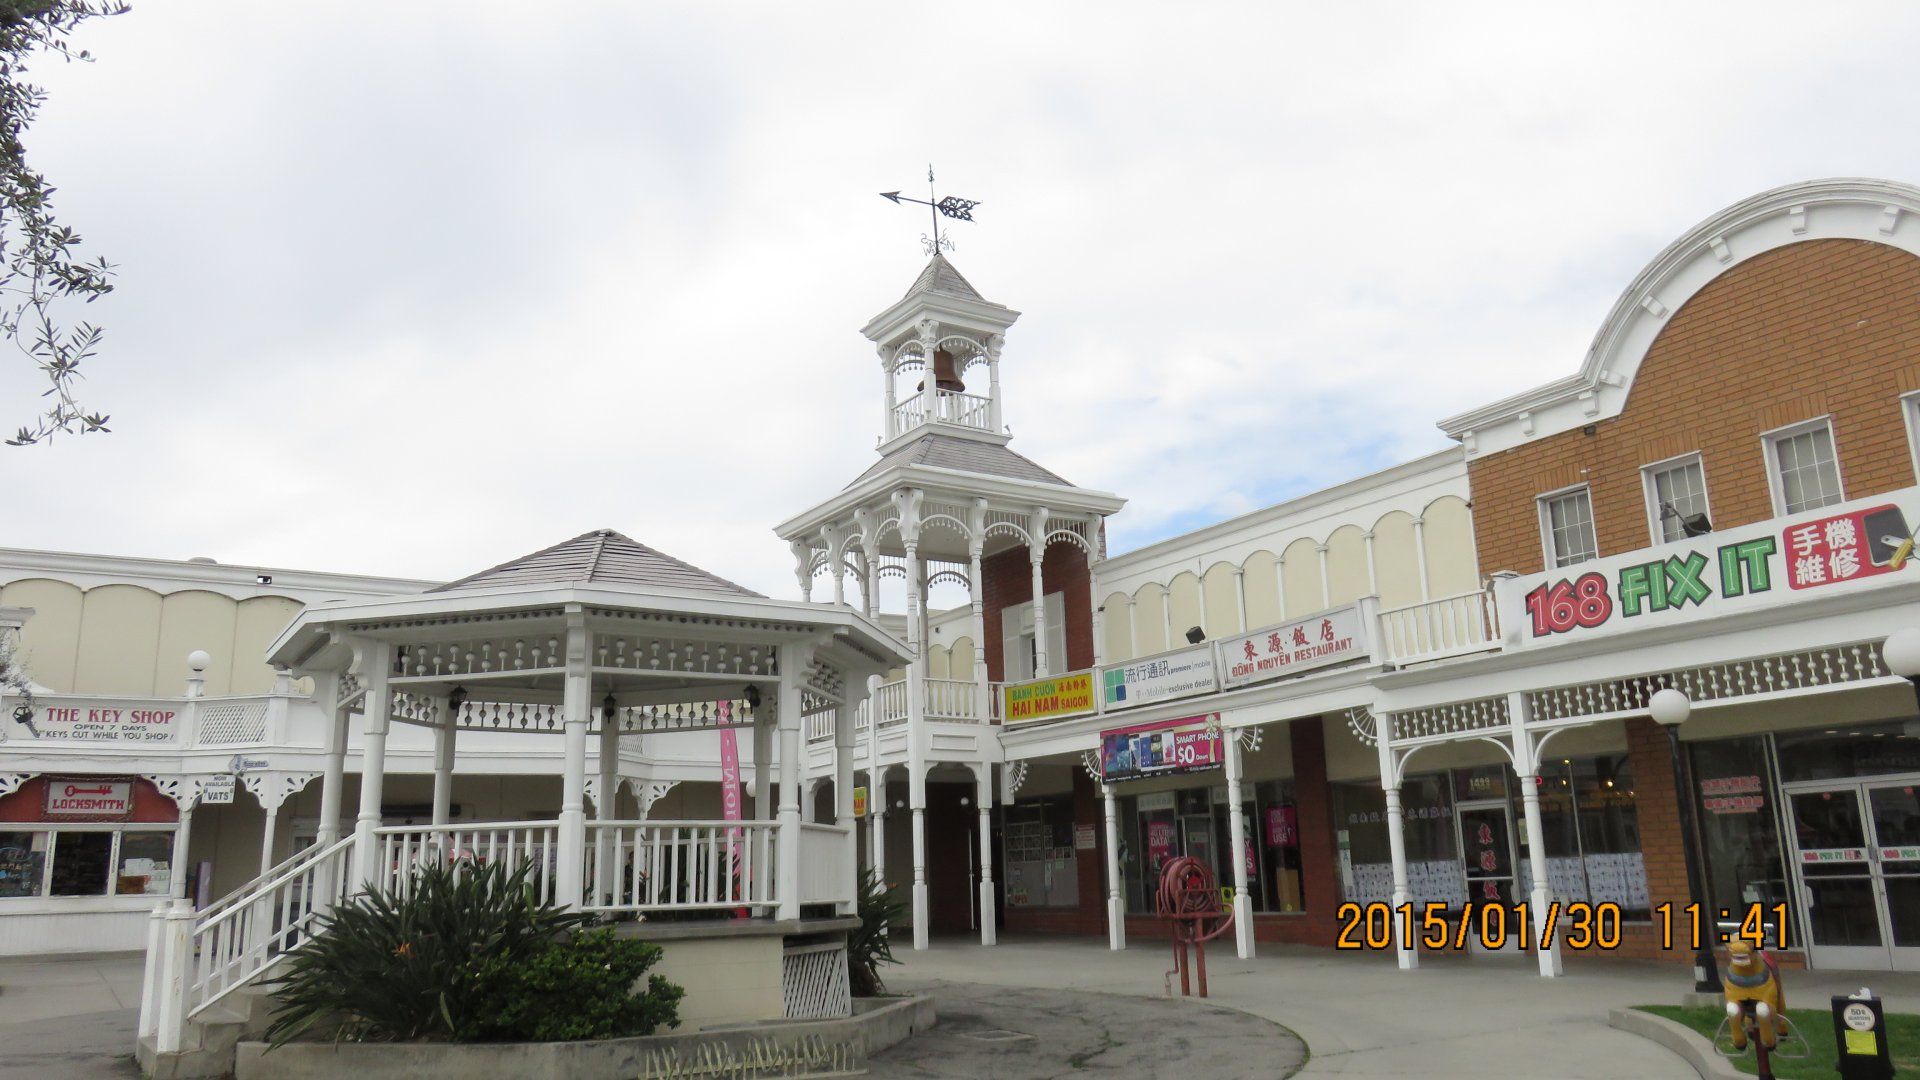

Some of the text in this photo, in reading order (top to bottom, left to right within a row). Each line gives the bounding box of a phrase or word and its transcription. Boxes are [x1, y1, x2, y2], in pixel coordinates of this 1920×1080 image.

[1791, 518, 1856, 557] 手機
[1795, 553, 1861, 586] 維修
[1526, 535, 1776, 637] 168 FIX IT
[1294, 637, 1353, 662] RESTAURANT
[1125, 660, 1169, 684] 流行通訊
[1168, 682, 1194, 693] exclusive
[1194, 678, 1213, 688] dealer
[46, 707, 175, 724] THE KEY SHOP
[1012, 695, 1088, 717] HAI NAM SAIGON
[93, 731, 119, 740] WHILE
[123, 732, 141, 740] YOU
[1176, 730, 1220, 745] SMART PHONE
[1177, 744, 1195, 765] $0
[52, 799, 126, 810] LOCKSMITH
